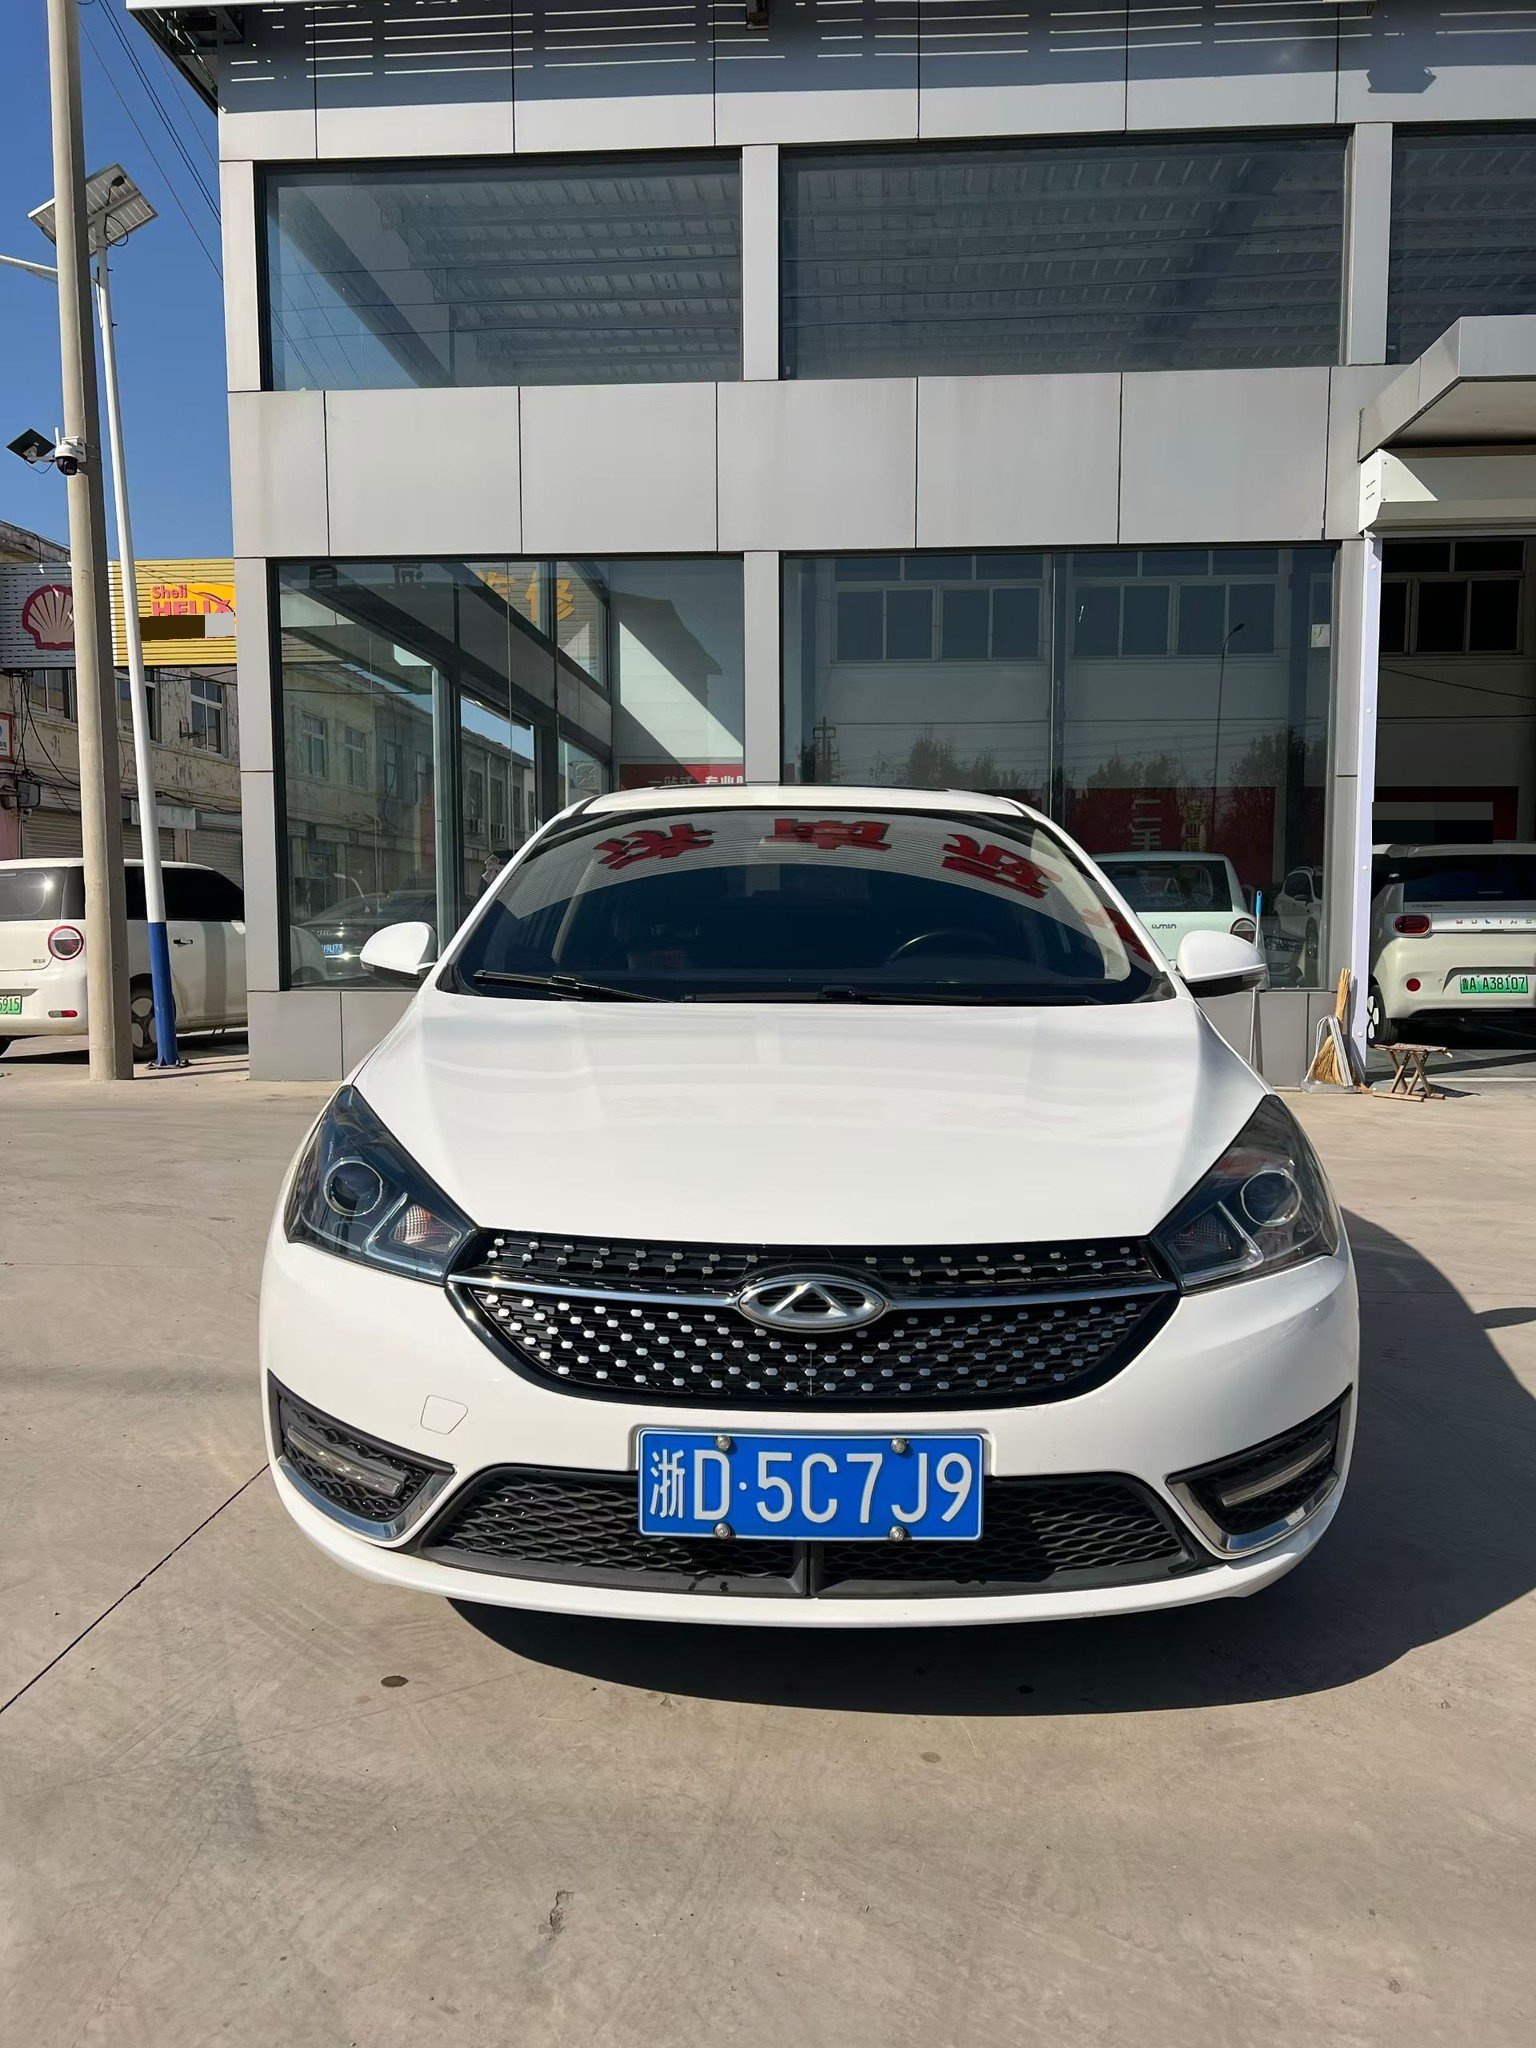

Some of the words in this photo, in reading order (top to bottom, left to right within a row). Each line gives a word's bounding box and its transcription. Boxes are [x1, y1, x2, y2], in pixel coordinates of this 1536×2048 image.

[151, 584, 188, 599] Shell
[705, 775, 744, 784] 专业
[650, 1448, 973, 1524] 浙D·5C7J9
